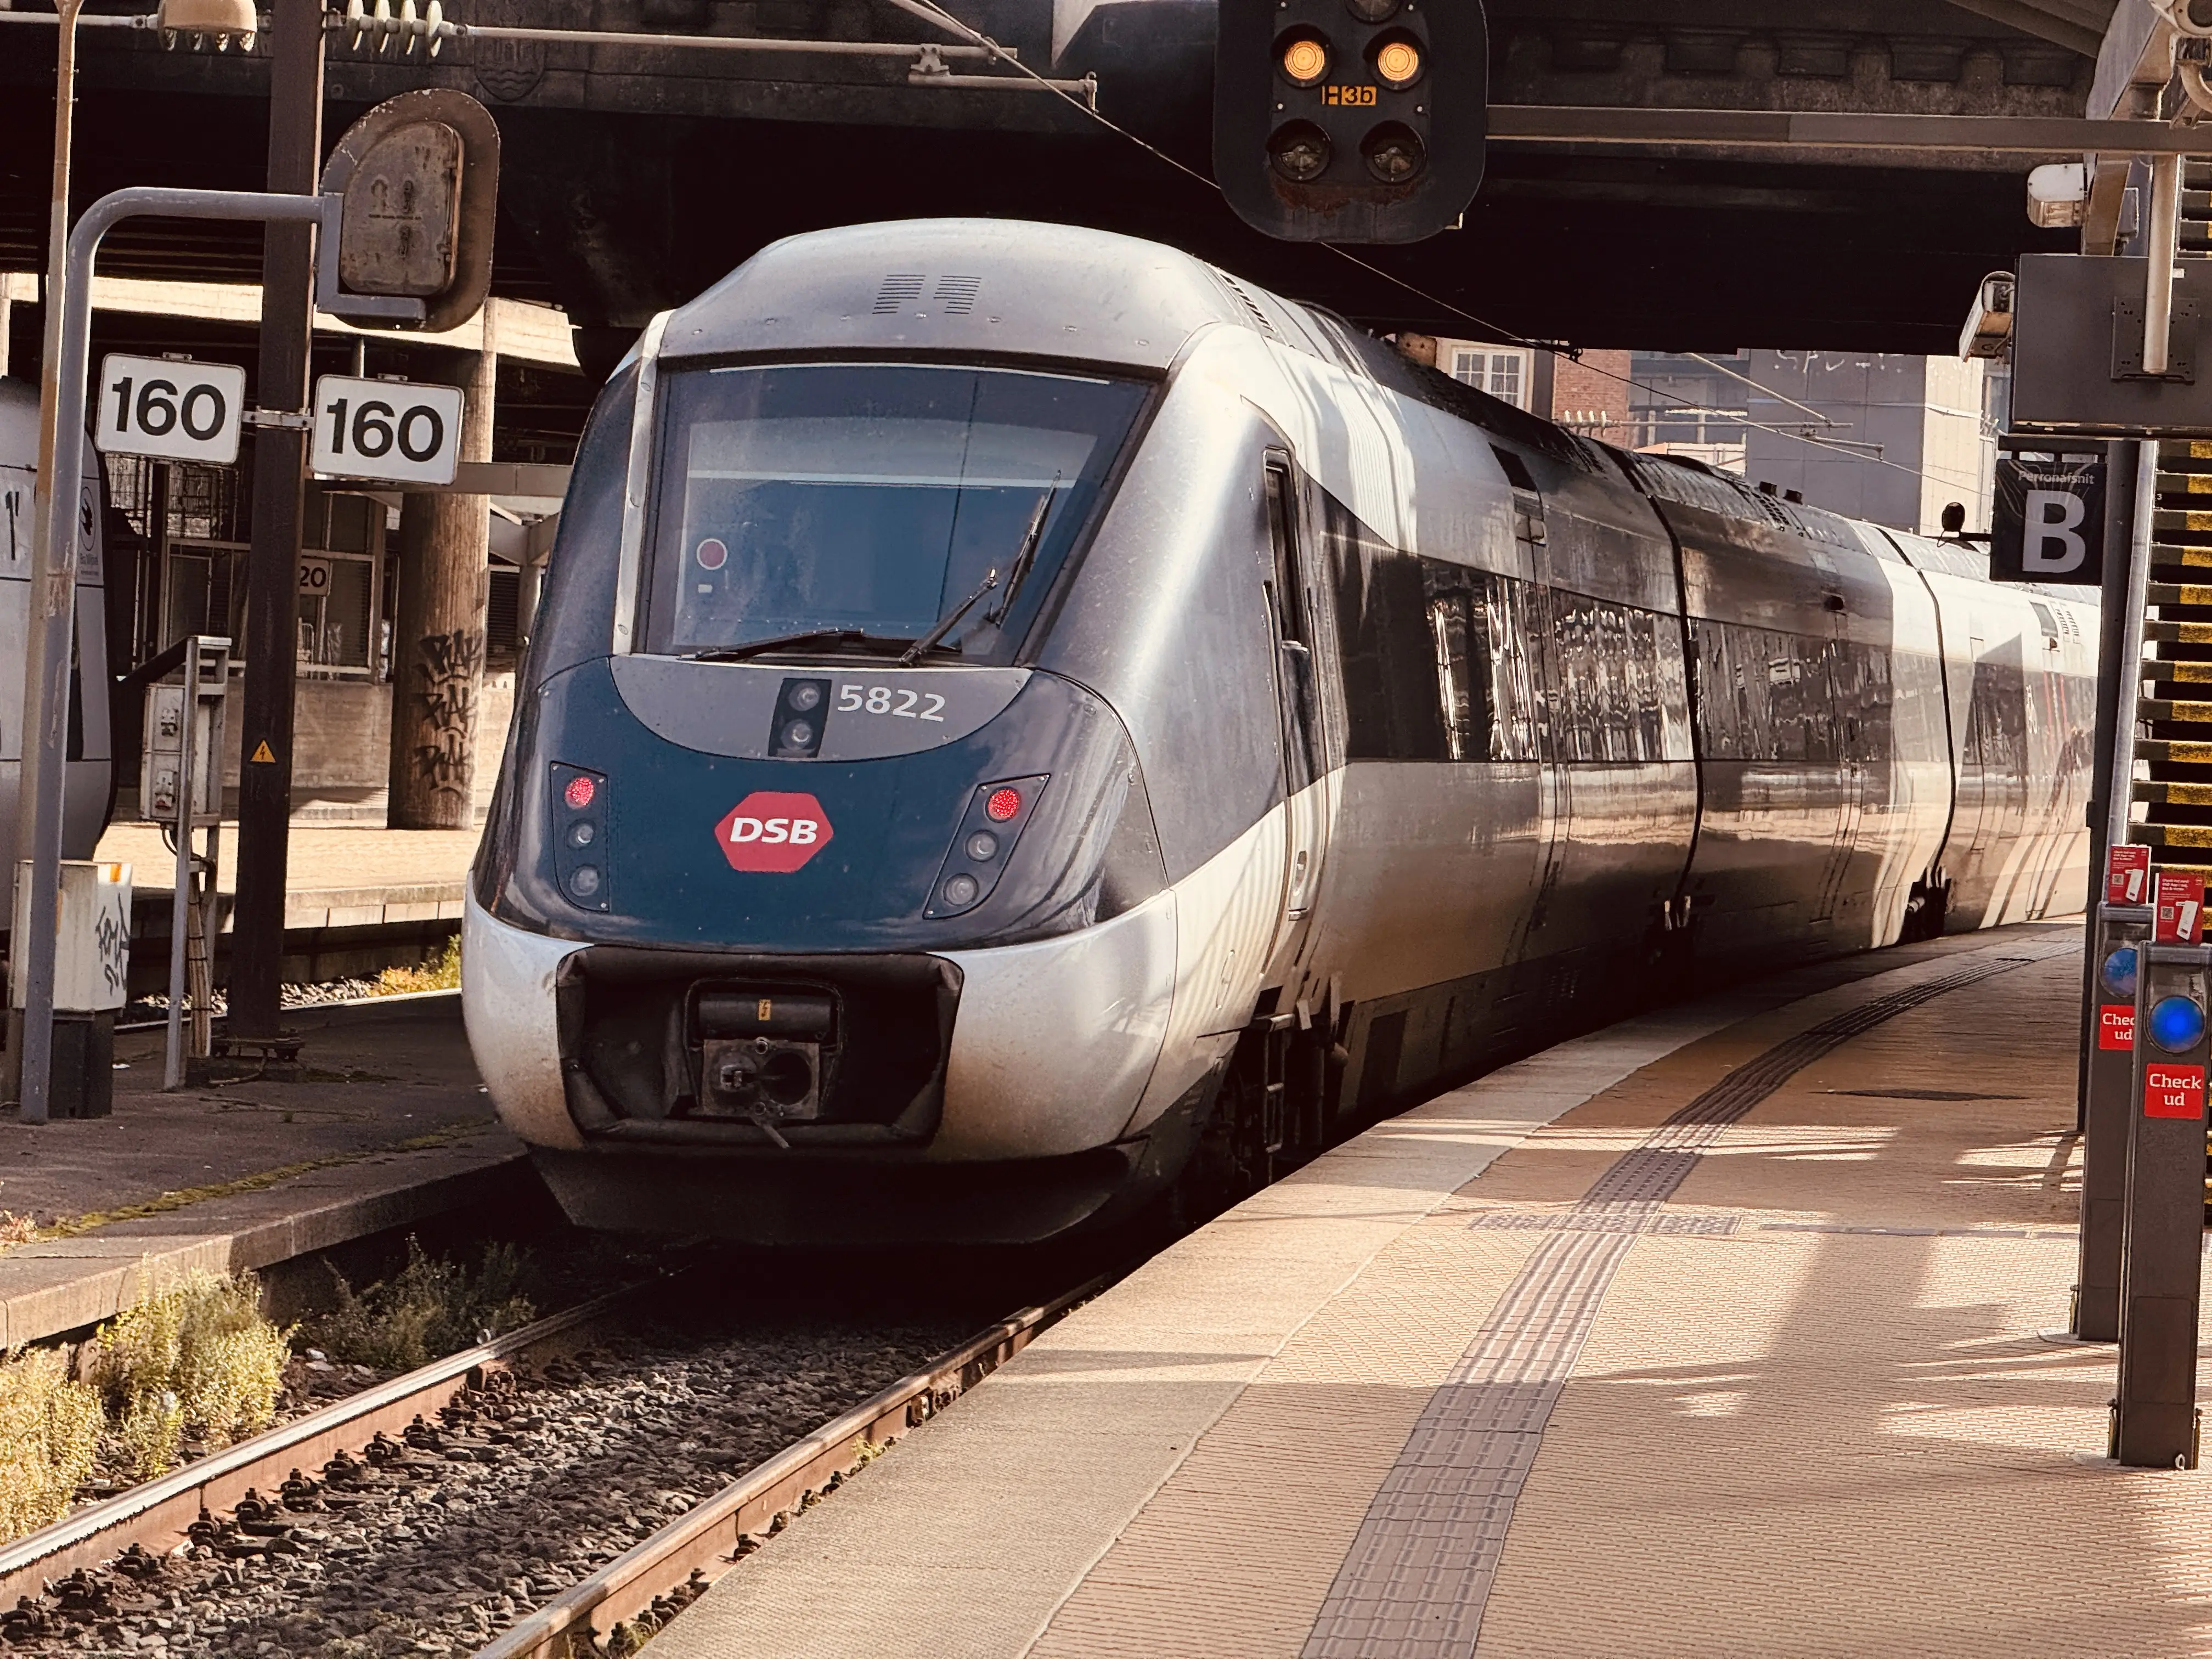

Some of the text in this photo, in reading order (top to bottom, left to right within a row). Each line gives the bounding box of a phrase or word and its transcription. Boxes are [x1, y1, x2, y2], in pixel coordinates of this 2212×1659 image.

[111, 376, 226, 441] 160
[326, 397, 444, 462] 160
[2018, 470, 2095, 484] Perronafsnit
[2022, 489, 2085, 573] B
[837, 684, 946, 723] 5822
[730, 817, 818, 845] DSB
[2102, 1013, 2135, 1026] Chec
[2114, 1029, 2133, 1041] ud
[2149, 1074, 2202, 1090] Check
[2164, 1092, 2185, 1106] ud
